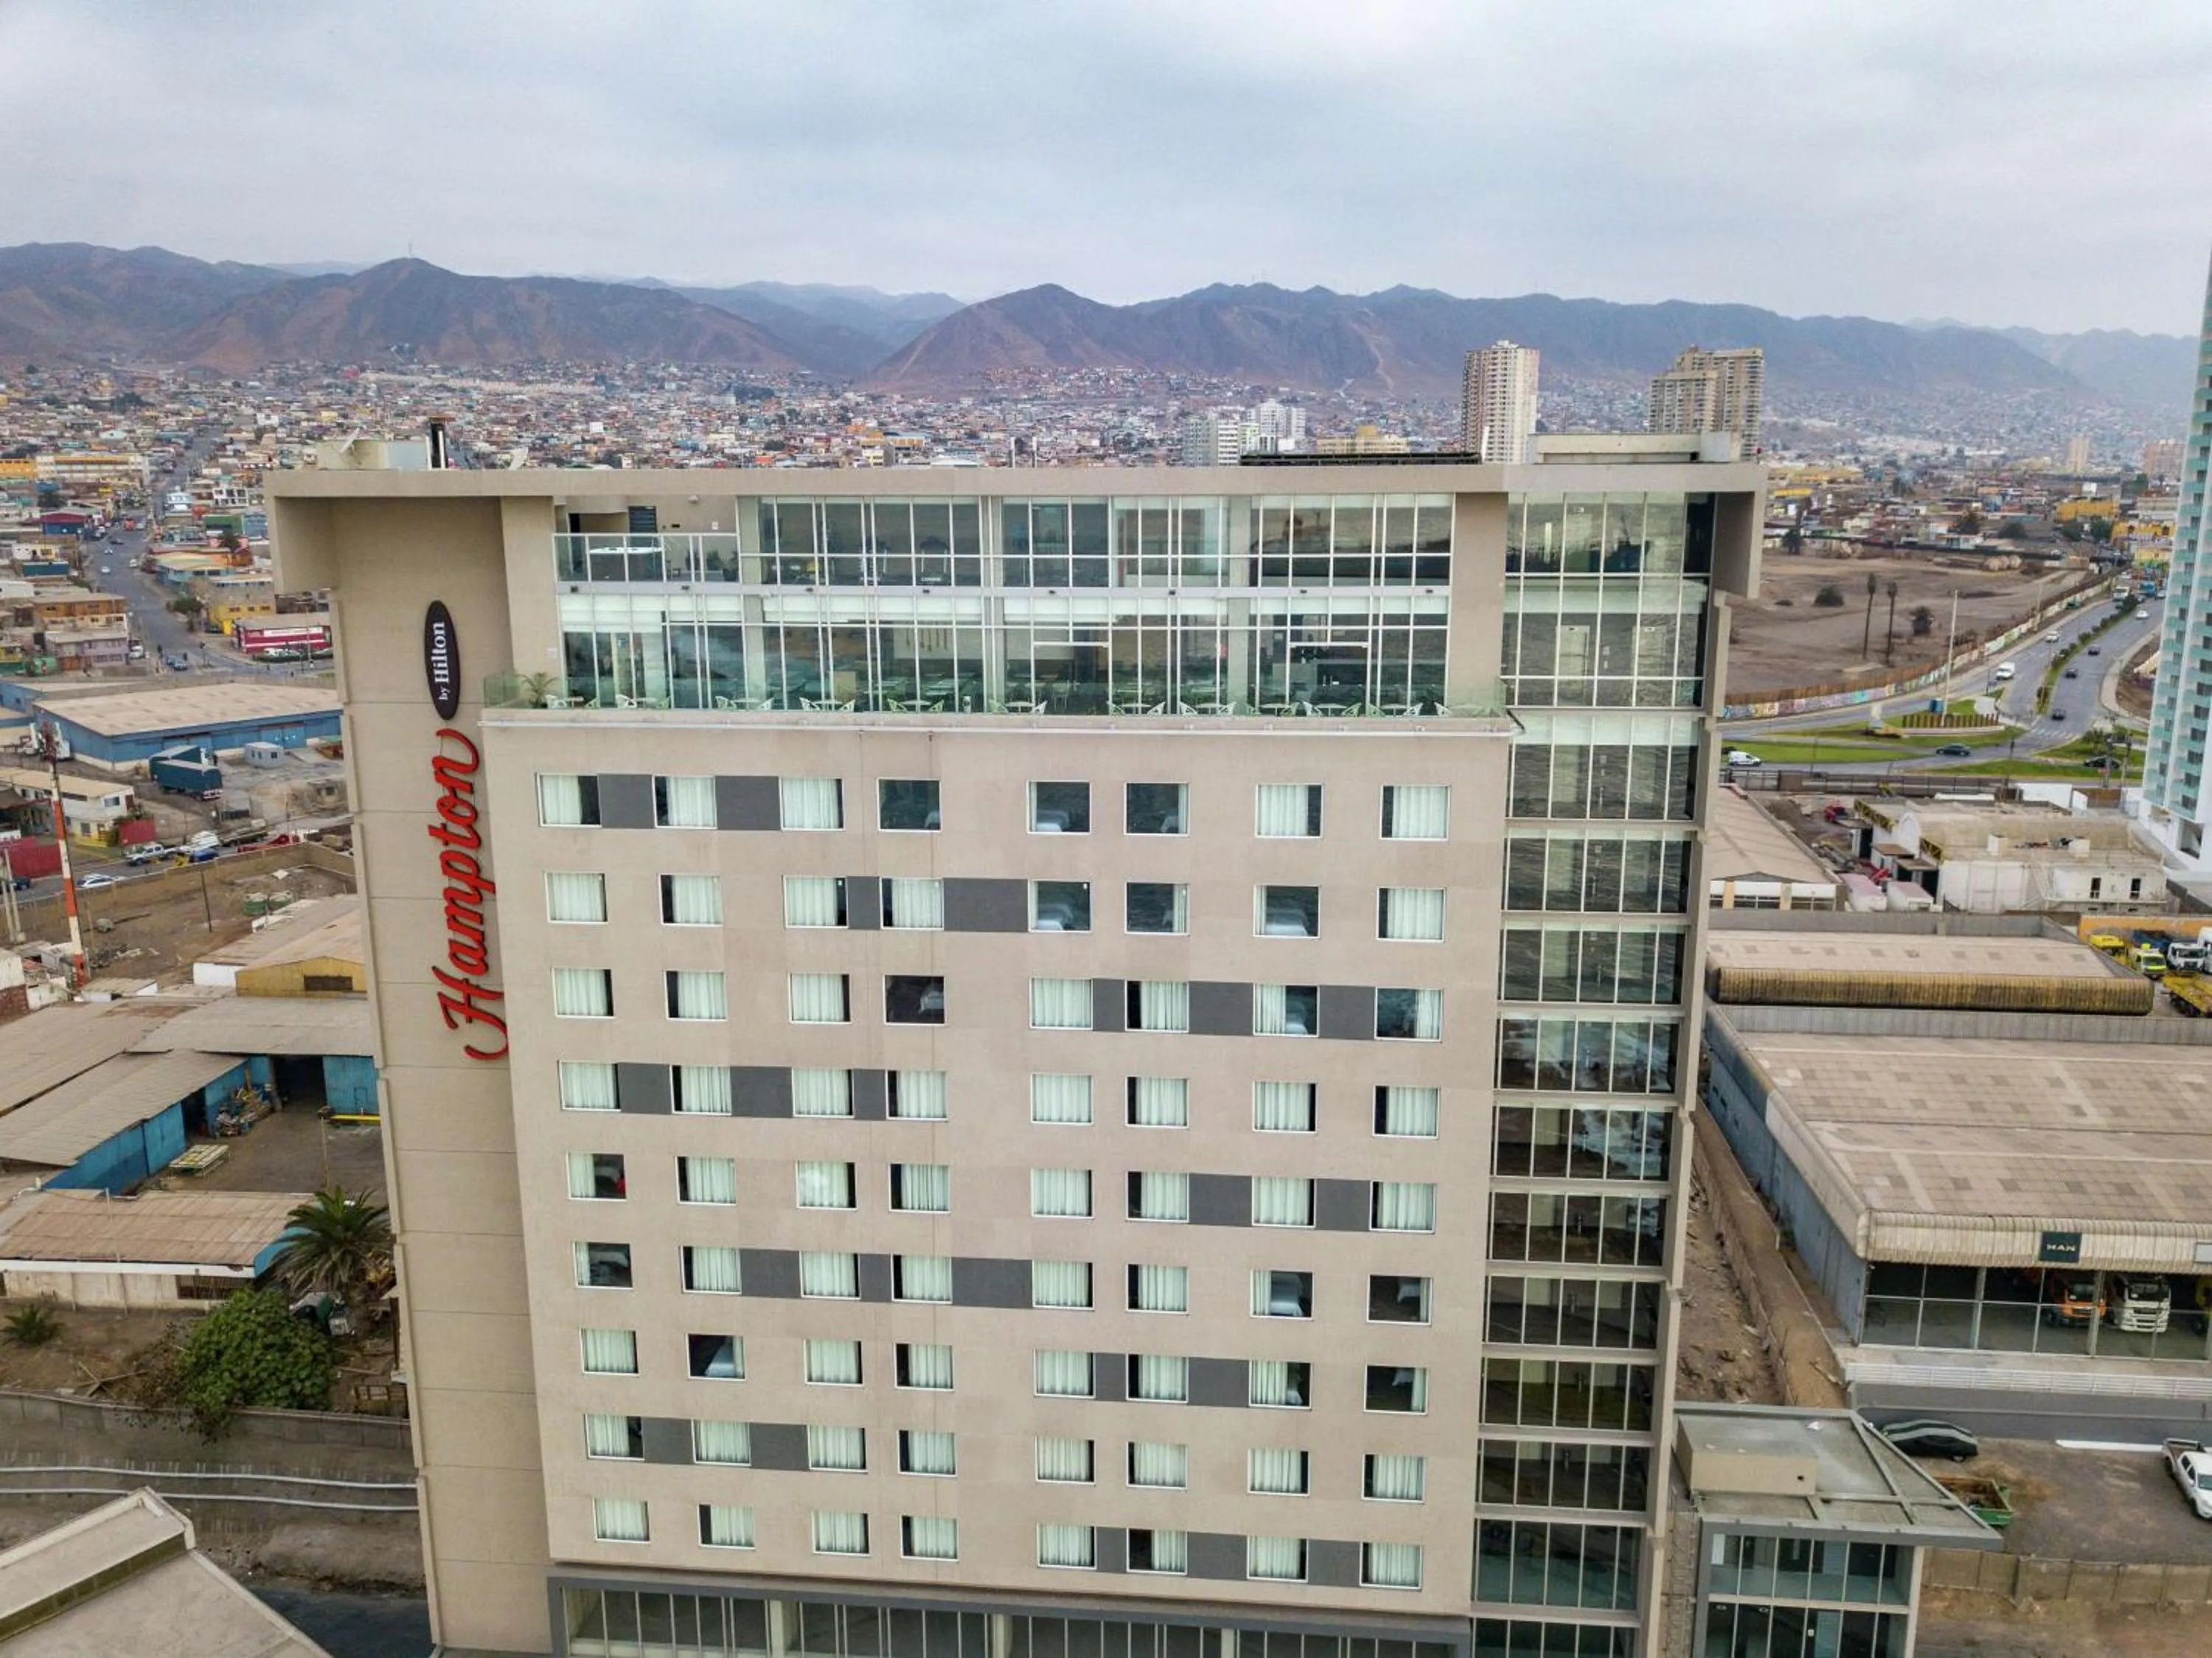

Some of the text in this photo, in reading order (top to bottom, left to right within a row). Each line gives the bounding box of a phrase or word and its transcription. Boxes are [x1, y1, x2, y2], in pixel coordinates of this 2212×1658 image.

[431, 622, 451, 701] by Hilton
[428, 728, 509, 1060] Hampton
[2046, 1244, 2076, 1252] MAN
